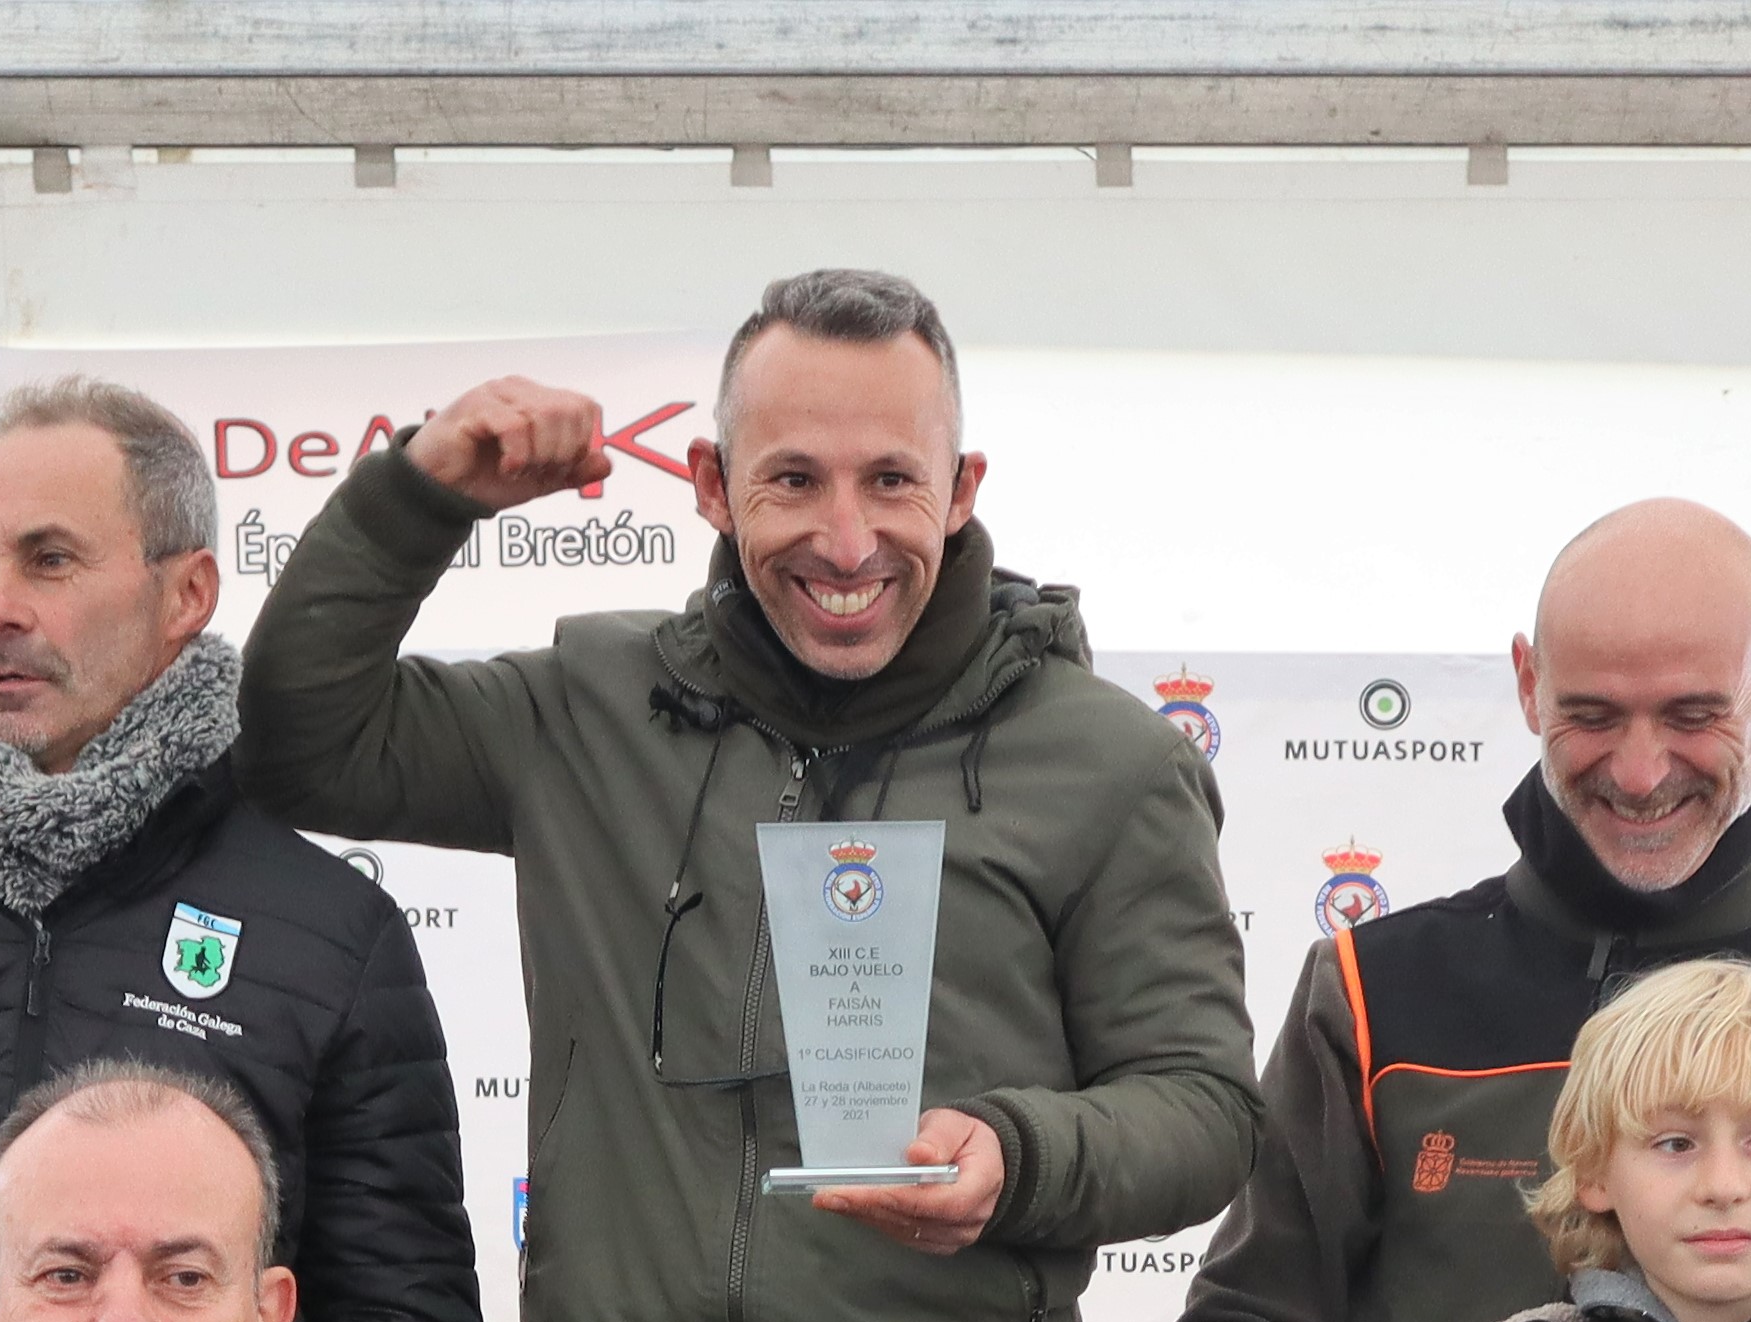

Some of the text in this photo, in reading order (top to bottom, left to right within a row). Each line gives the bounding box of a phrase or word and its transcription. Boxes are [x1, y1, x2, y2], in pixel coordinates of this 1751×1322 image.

[499, 510, 675, 567] Bretón
[1284, 740, 1484, 763] MUTUASPORT
[828, 947, 851, 960] XIII
[809, 963, 903, 978] BAJO VUELO
[850, 981, 860, 994] A
[828, 995, 881, 1010] FAISÁN
[123, 992, 243, 1036] Federación Galega
[827, 1014, 883, 1027] HARRIS
[158, 1014, 207, 1040] de Caza
[815, 1047, 914, 1061] CLASIFICADO
[801, 1080, 911, 1094] La Roda (Albacete)
[804, 1096, 818, 1107] 27
[849, 1094, 908, 1106] noviembre
[842, 1110, 870, 1121] 2021
[1096, 1251, 1205, 1274] TUASP
